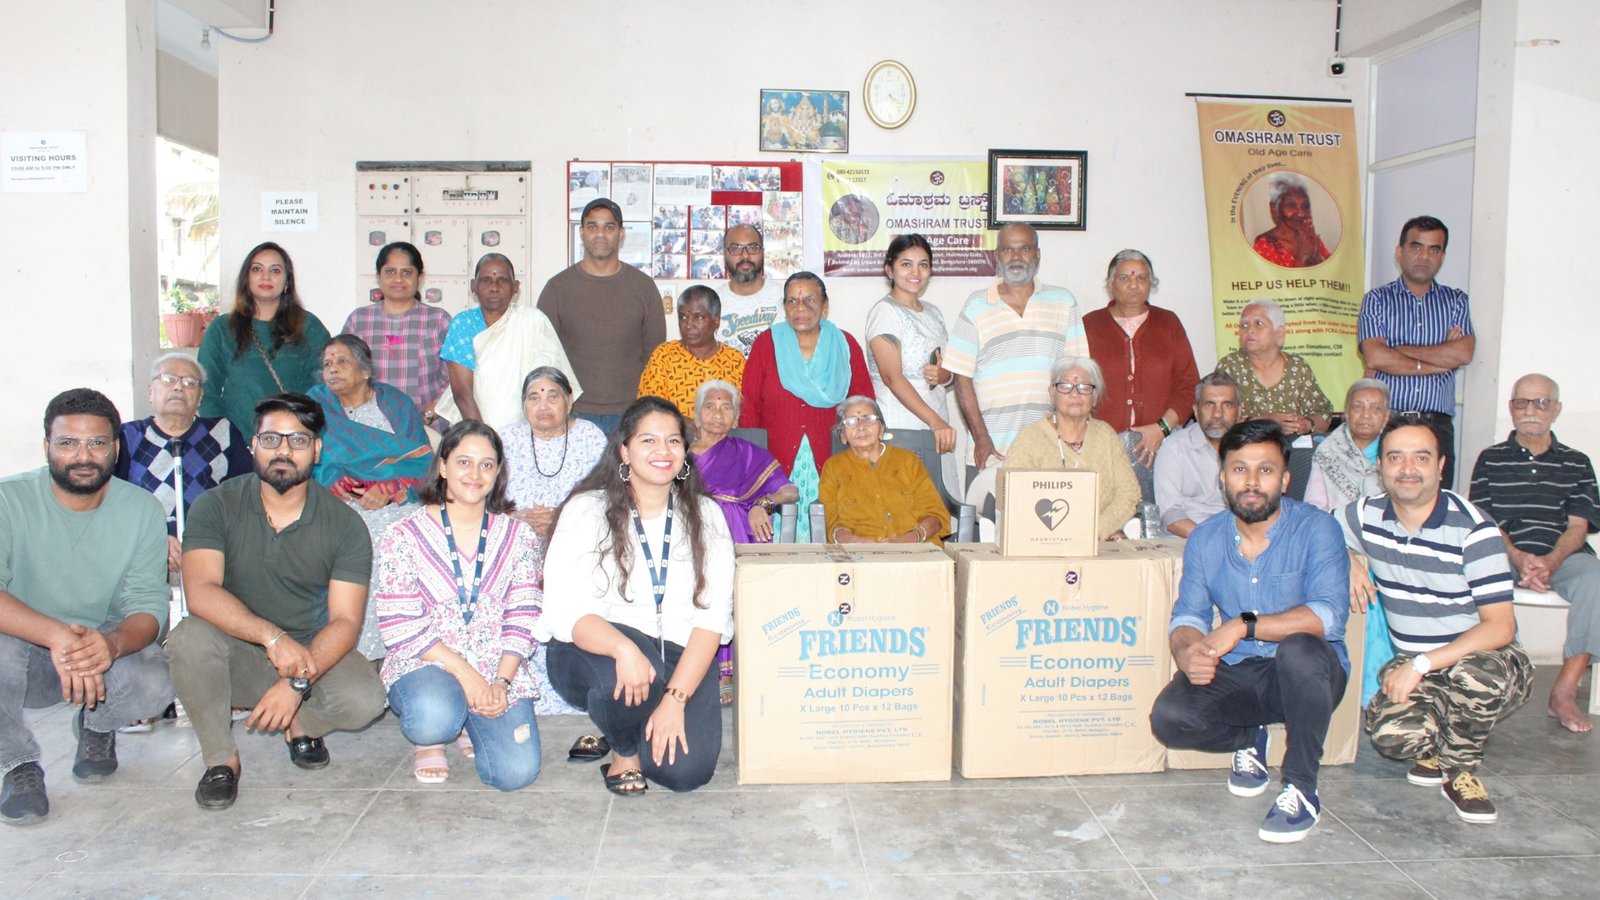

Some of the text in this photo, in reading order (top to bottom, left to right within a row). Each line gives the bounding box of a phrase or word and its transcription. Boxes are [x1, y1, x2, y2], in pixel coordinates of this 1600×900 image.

[1214, 130, 1342, 146] OMASHRAM TRUST
[1247, 148, 1313, 158] Old Age Care
[886, 218, 988, 229] OMASHRAM TRUST
[926, 235, 970, 247] Age Care
[1231, 279, 1351, 293] HELP US HELP THEM!!
[721, 308, 778, 337] Speedway
[1032, 480, 1073, 490] PHILIPS
[979, 595, 1018, 625] FRIENDS
[1062, 603, 1109, 612] Nobel Hygiene
[761, 607, 801, 635] FRIENDS
[847, 614, 896, 623] Nobel Hygiene
[985, 607, 1023, 631] Economy
[1016, 615, 1138, 650] FRIENDS
[799, 626, 927, 661] FRIENDS
[1030, 654, 1127, 672] Economy
[808, 663, 910, 682] Economy
[1024, 676, 1130, 690] Adult Diapers
[804, 685, 915, 699] Adult Diapers
[1019, 694, 1027, 703] X
[1028, 694, 1055, 704] Large
[1058, 694, 1068, 702] 10
[1070, 693, 1087, 702] Pcs
[1098, 693, 1108, 702] 12
[1110, 692, 1133, 703] Bags
[800, 704, 807, 713] X
[809, 703, 837, 714] Large
[839, 703, 850, 712] 10
[852, 703, 870, 712] Pcs
[881, 703, 892, 711] 12
[894, 702, 919, 713] Bags
